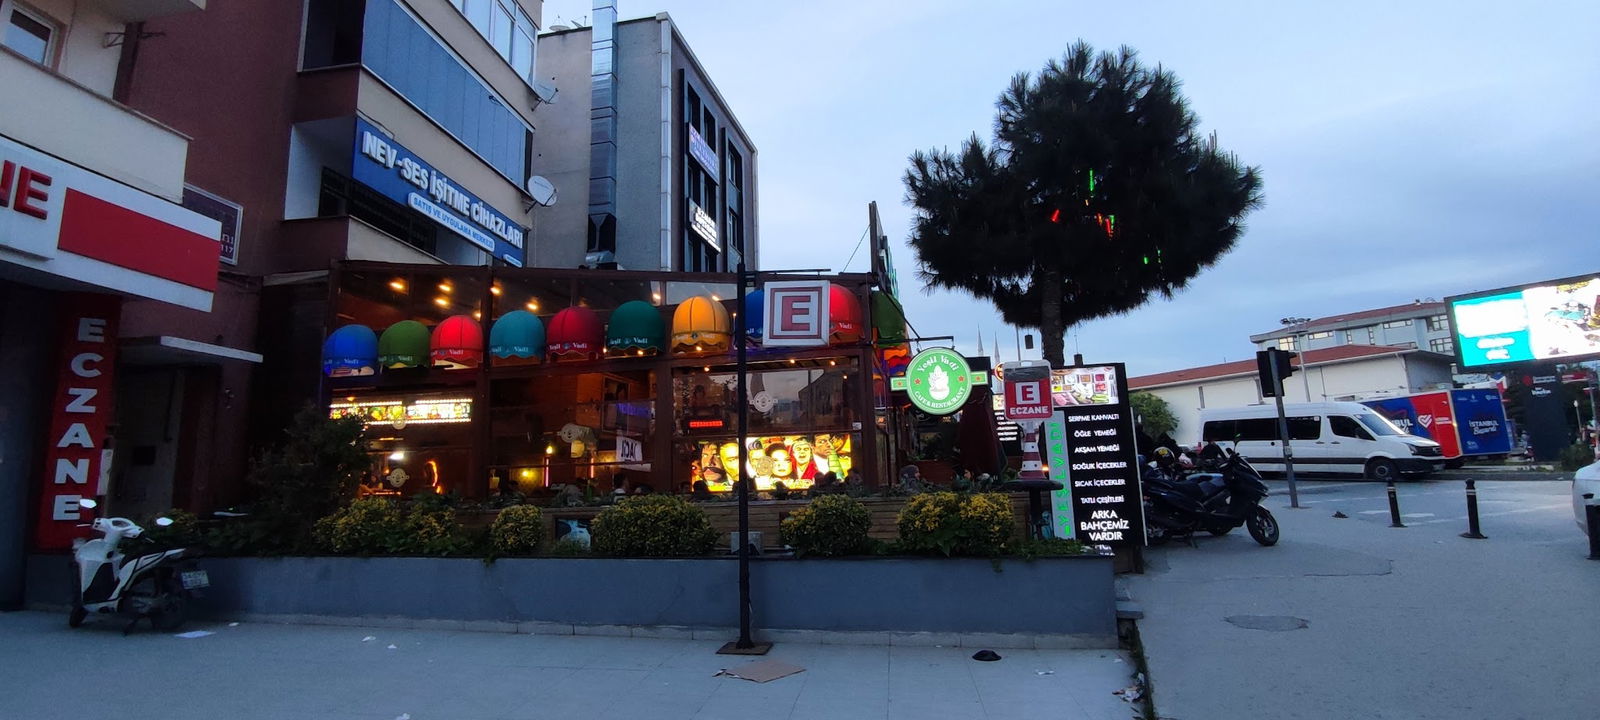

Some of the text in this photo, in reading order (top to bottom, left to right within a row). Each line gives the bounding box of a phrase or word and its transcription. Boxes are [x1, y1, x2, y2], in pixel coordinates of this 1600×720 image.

[362, 131, 523, 249] NEV-SES İŞİTME CİHAZLARI
[442, 213, 471, 236] UYGULAMA
[781, 295, 811, 331] E
[917, 355, 960, 372] Yeşil Vadi
[1021, 385, 1034, 401] E
[1009, 405, 1049, 415] ECZANE
[53, 317, 107, 520] ECZANE
[1072, 461, 1127, 470] SOĞUK İÇECEKLER
[1093, 478, 1126, 487] İÇECEKLER
[1091, 510, 1118, 519] ARKA
[1080, 519, 1130, 532] BAHÇEMİZ
[1089, 532, 1124, 541] VARDIR
